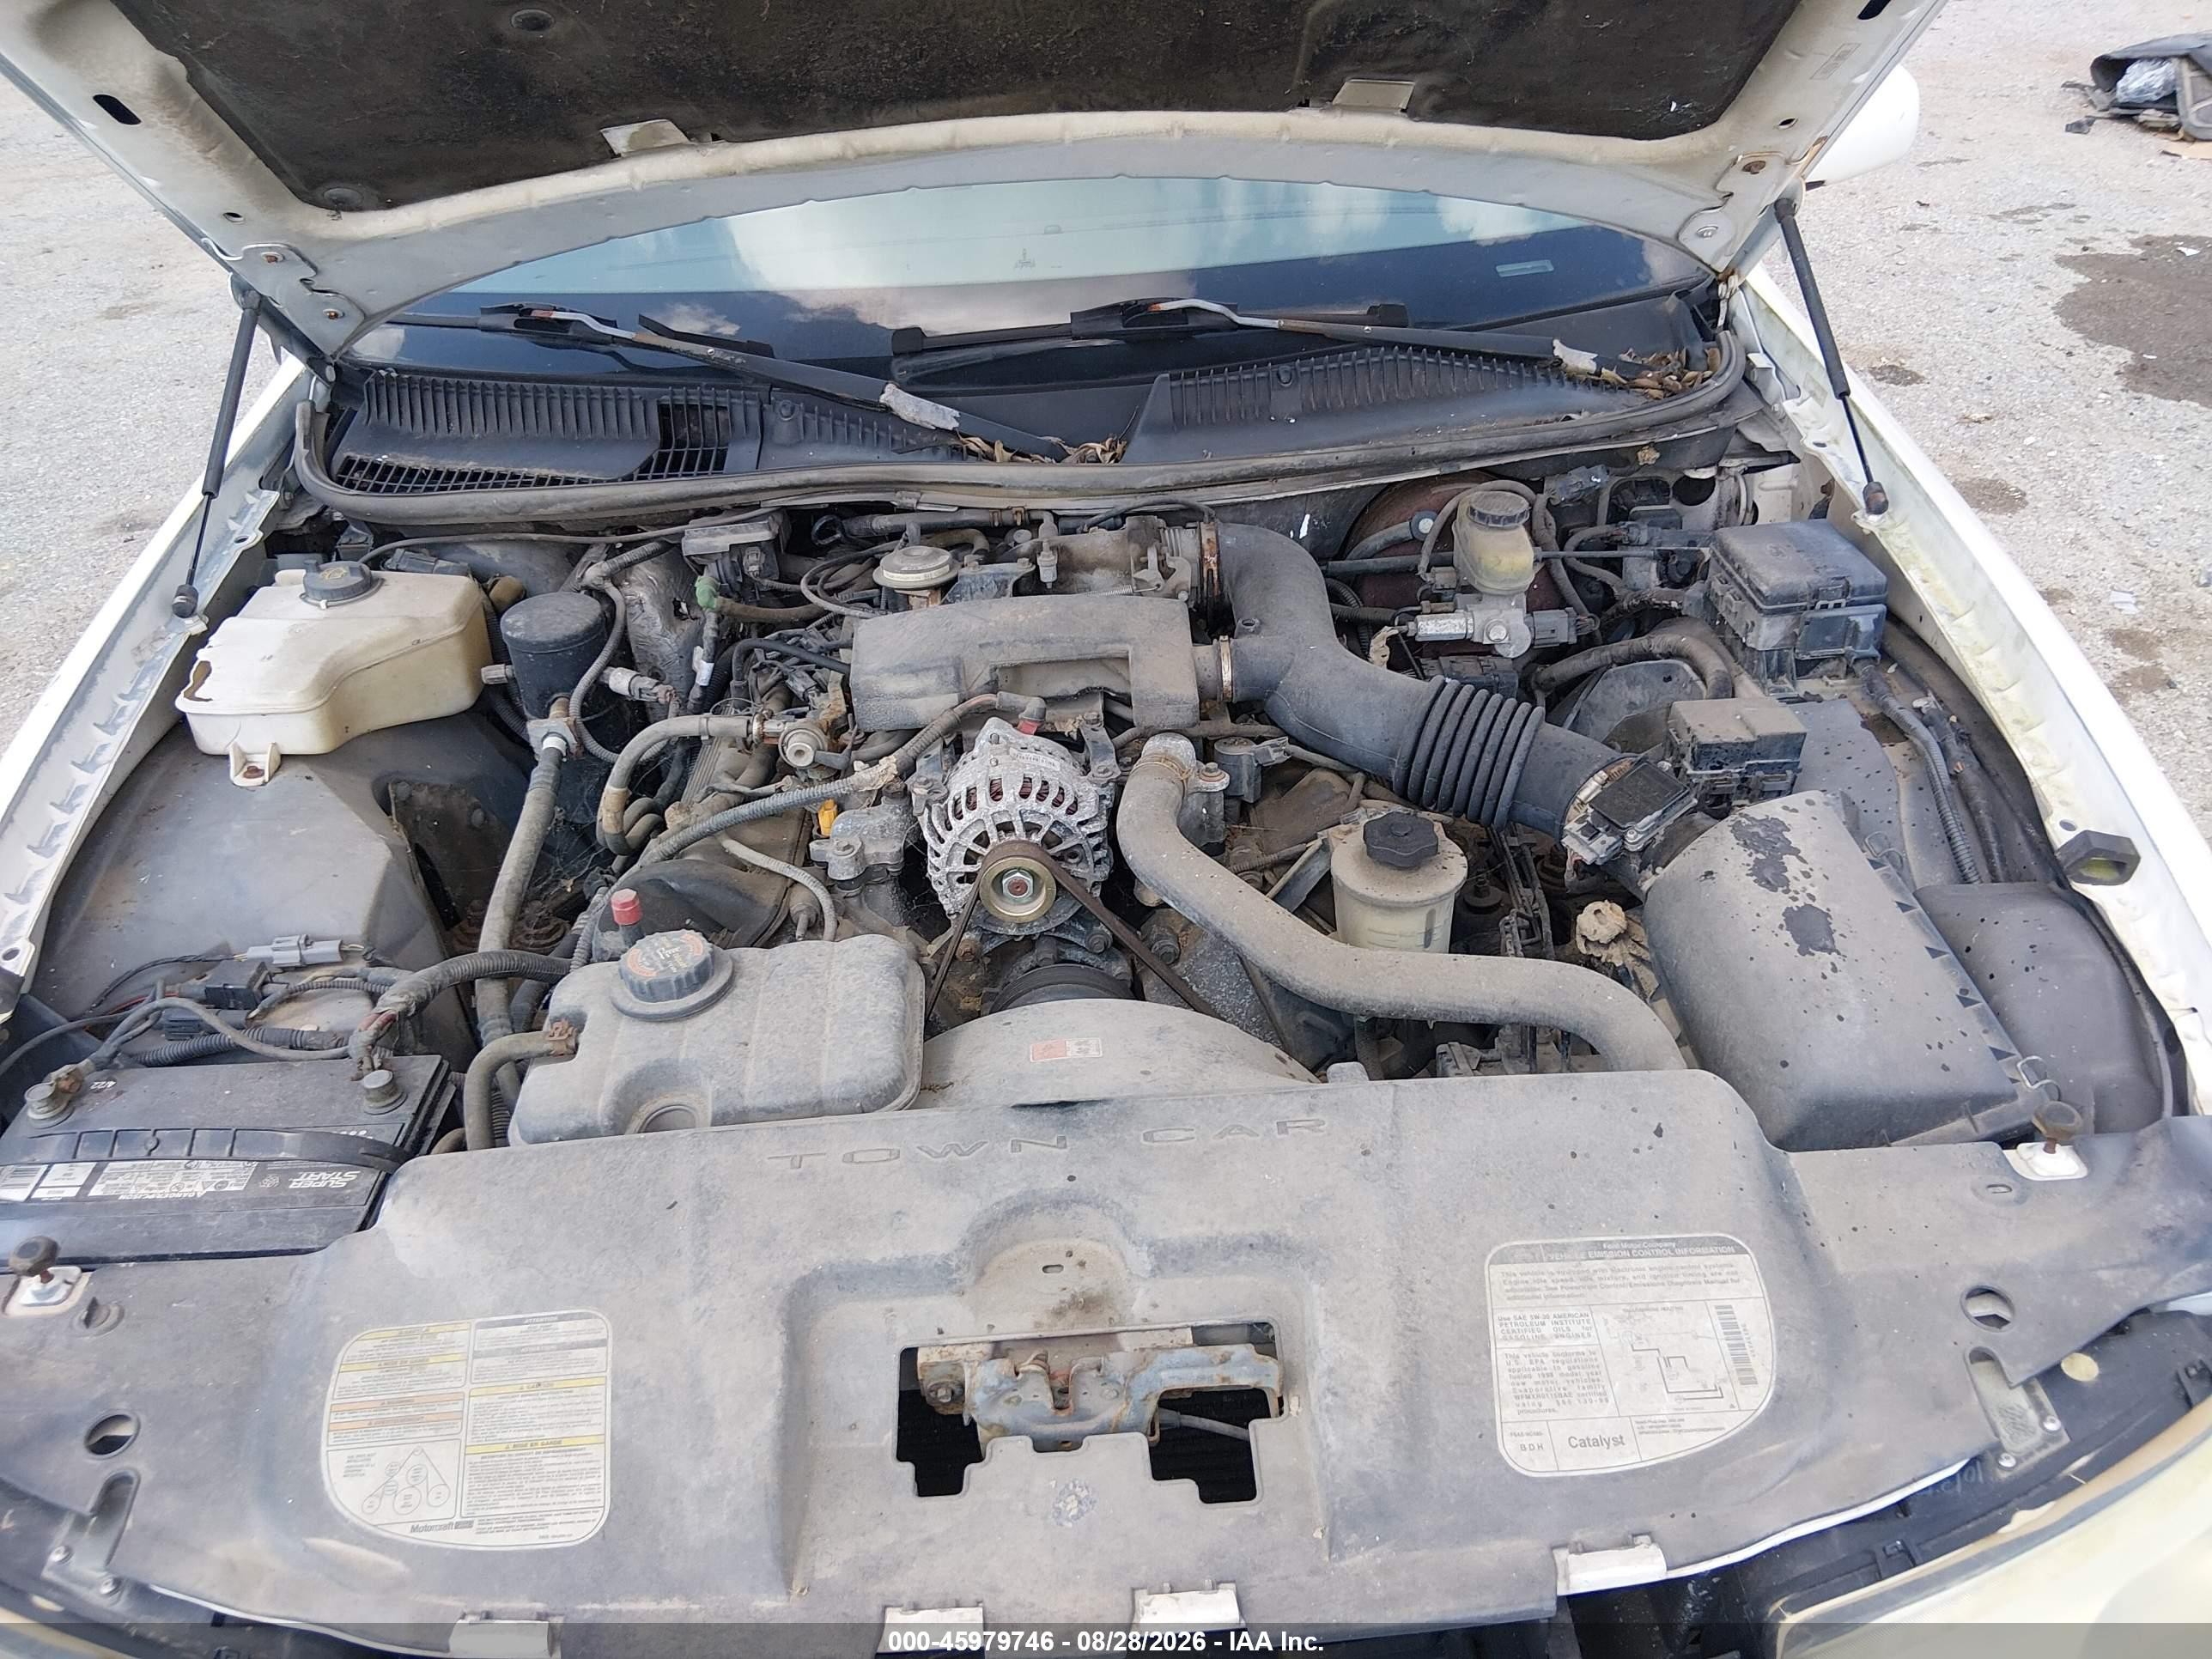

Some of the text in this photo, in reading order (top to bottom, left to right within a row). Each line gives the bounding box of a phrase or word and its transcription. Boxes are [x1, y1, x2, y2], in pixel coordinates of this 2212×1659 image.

[767, 1119, 1326, 1169] TOWN CAR
[297, 1170, 361, 1181] START
[289, 1180, 347, 1188] SUPER
[1642, 1241, 1675, 1249] Company
[1588, 1249, 1630, 1258] EMISSION
[1632, 1248, 1674, 1257] CONTROL
[1674, 1245, 1735, 1255] INFORMATION
[1568, 1434, 1626, 1449] Catalyst
[410, 1522, 454, 1534] Motorcraft
